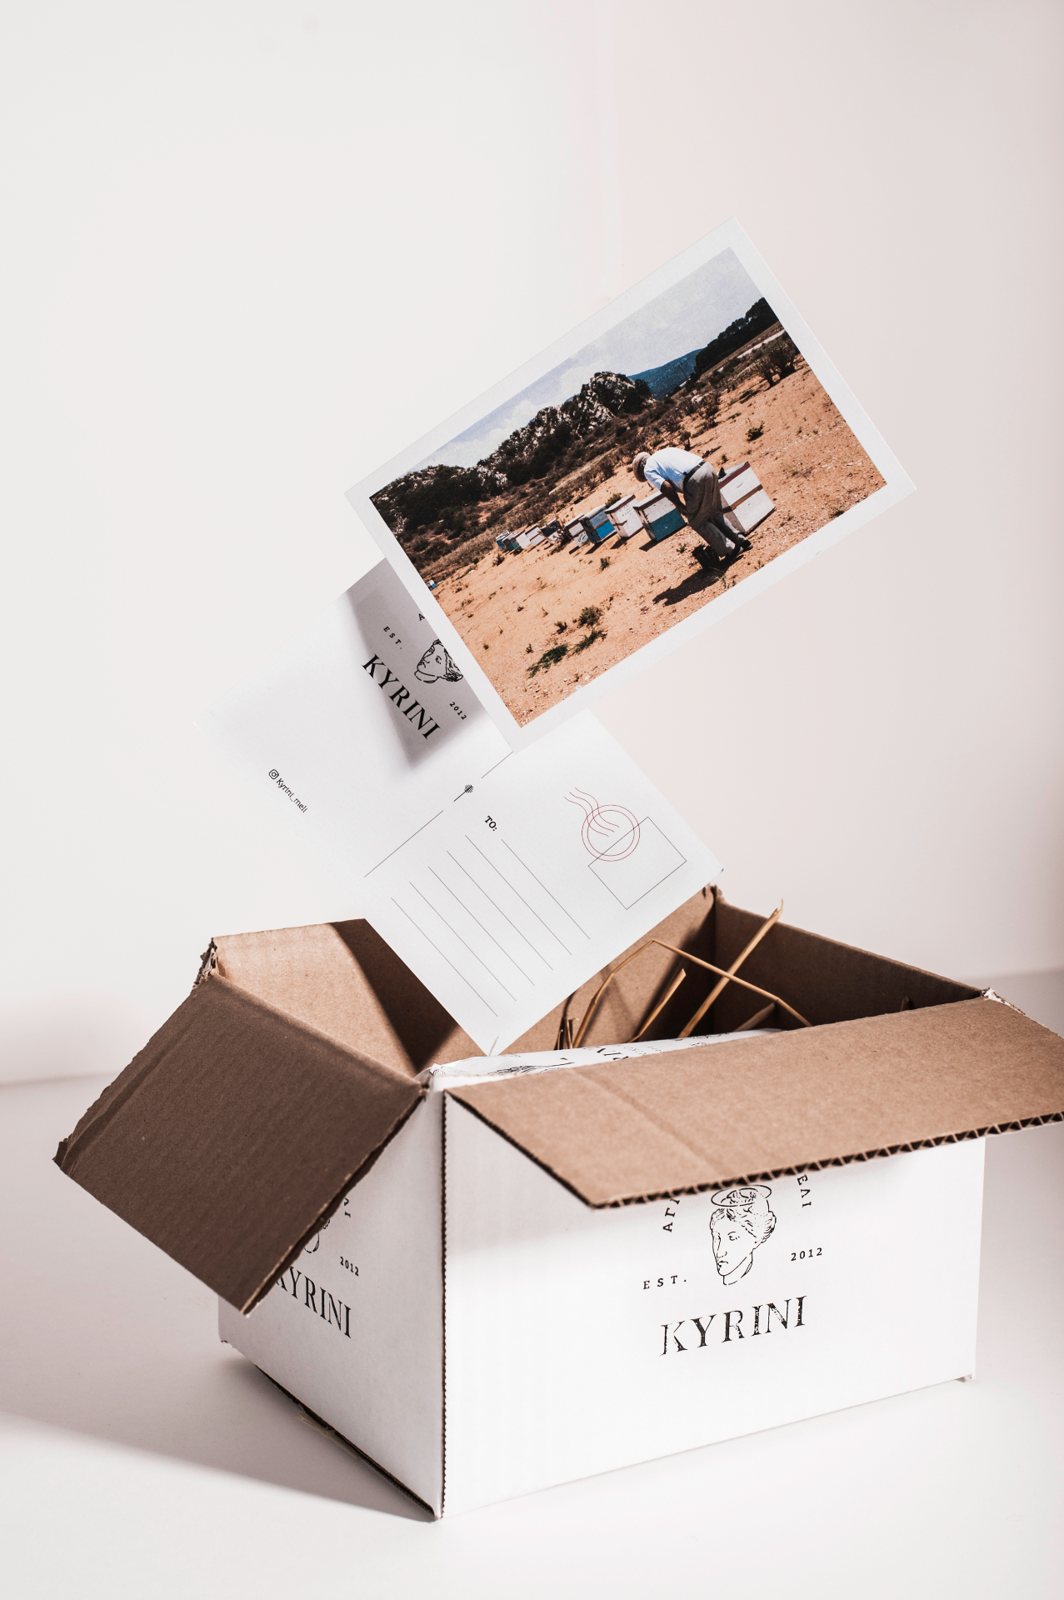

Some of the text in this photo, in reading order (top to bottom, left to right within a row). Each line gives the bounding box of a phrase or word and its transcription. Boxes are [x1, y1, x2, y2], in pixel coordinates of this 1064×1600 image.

[383, 625, 402, 650] EST.
[362, 653, 441, 740] KYRINI
[449, 701, 468, 721] 2012
[275, 777, 309, 814] Kyrini_meli
[484, 814, 498, 832] TO:
[790, 1247, 824, 1262] 2012
[340, 1256, 360, 1277] 2012
[642, 1274, 688, 1290] EST.
[659, 1295, 808, 1357] KYRINI
